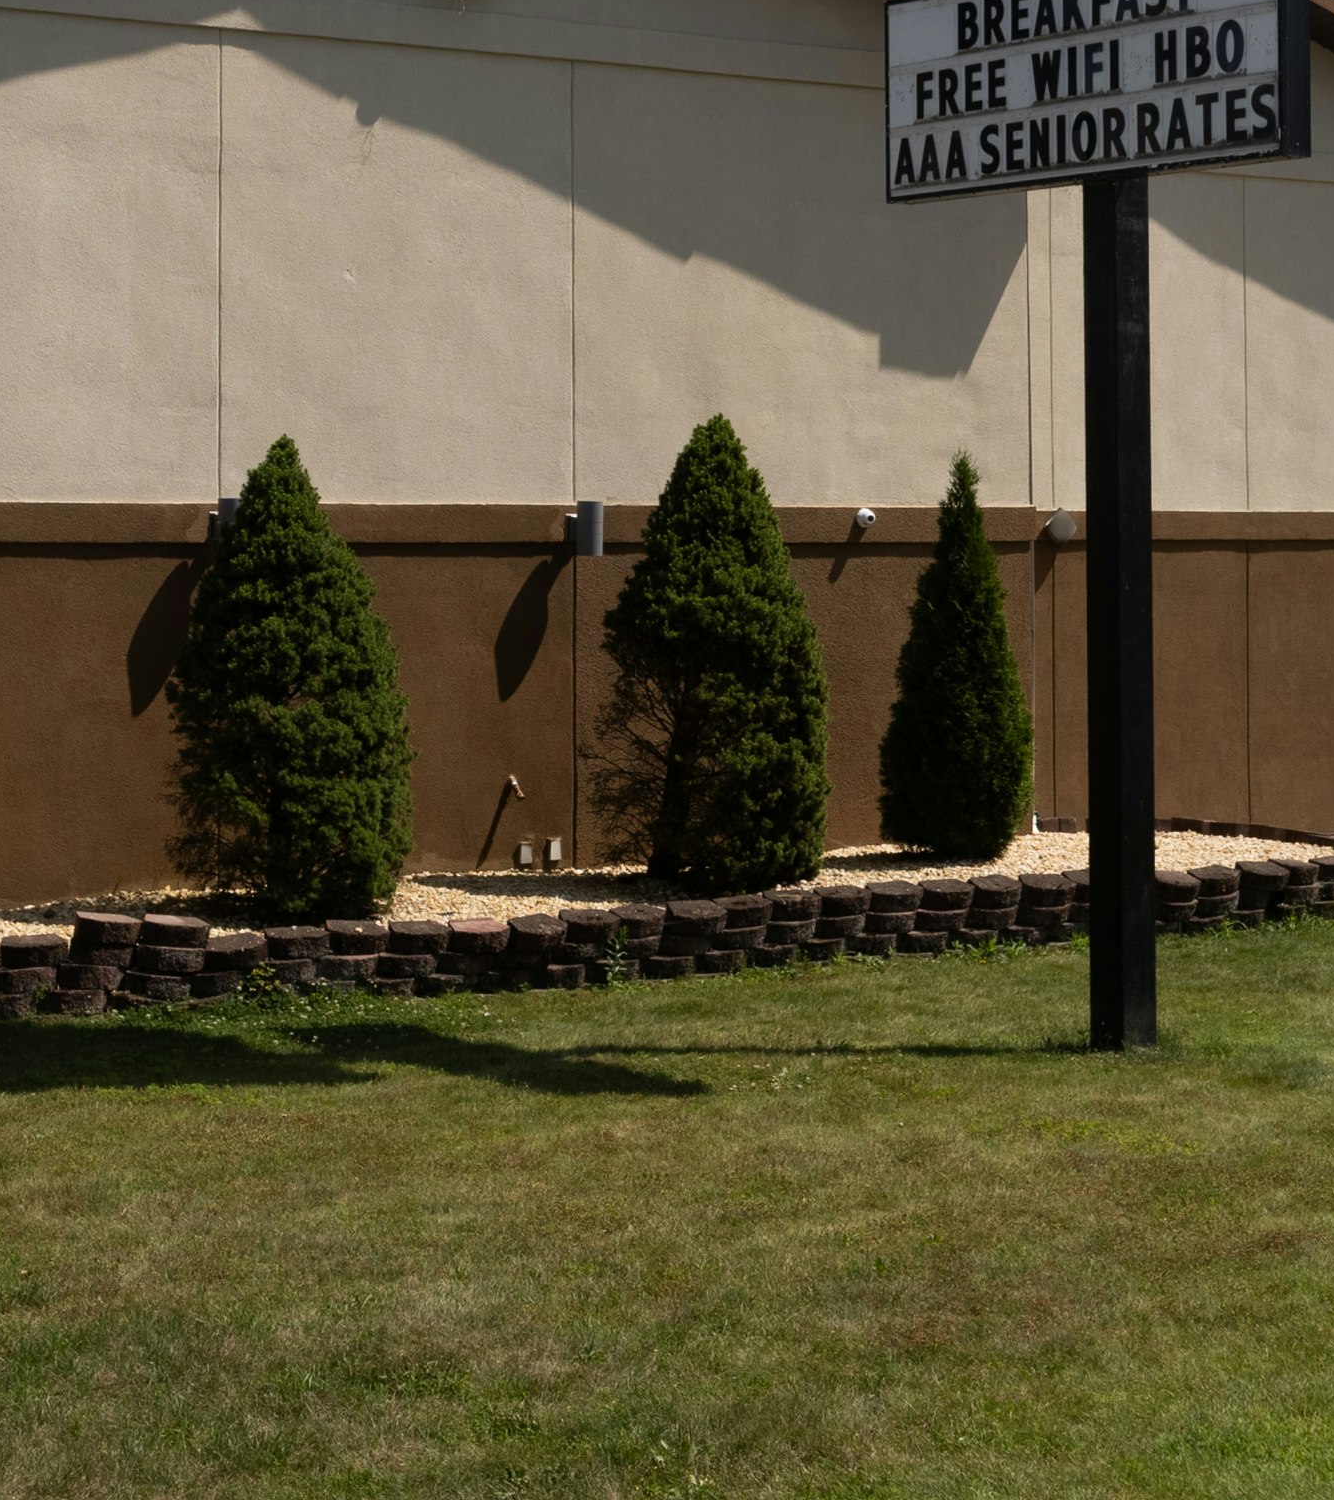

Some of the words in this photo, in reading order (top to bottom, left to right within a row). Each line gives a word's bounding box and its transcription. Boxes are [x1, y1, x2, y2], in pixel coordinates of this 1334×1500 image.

[915, 58, 1006, 119] FREE
[1031, 39, 1119, 100] WIFI
[1154, 19, 1245, 84] HBO
[894, 130, 967, 184] AAA
[979, 107, 1127, 175] SENIOR
[1136, 84, 1277, 155] RATES
